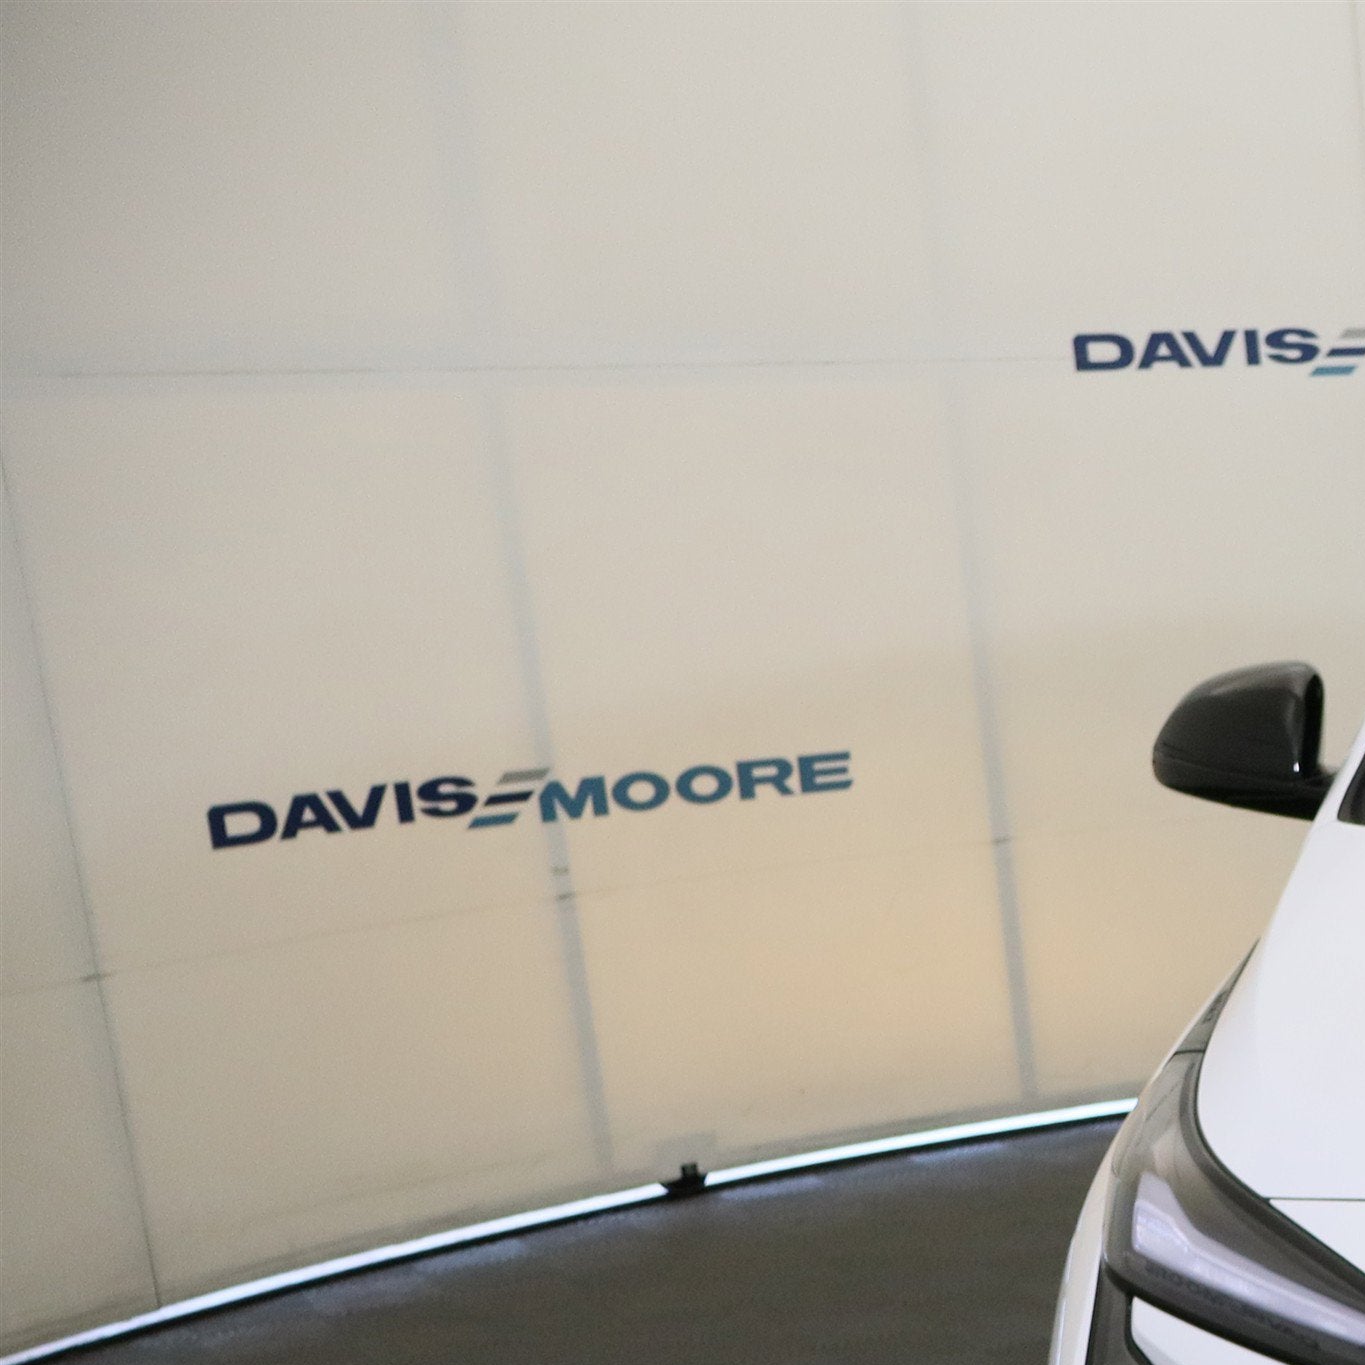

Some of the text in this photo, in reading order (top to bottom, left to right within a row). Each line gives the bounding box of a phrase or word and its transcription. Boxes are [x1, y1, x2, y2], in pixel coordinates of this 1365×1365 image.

[1071, 327, 1322, 373] DAVIS
[205, 750, 854, 852] DAVIS MOORE
